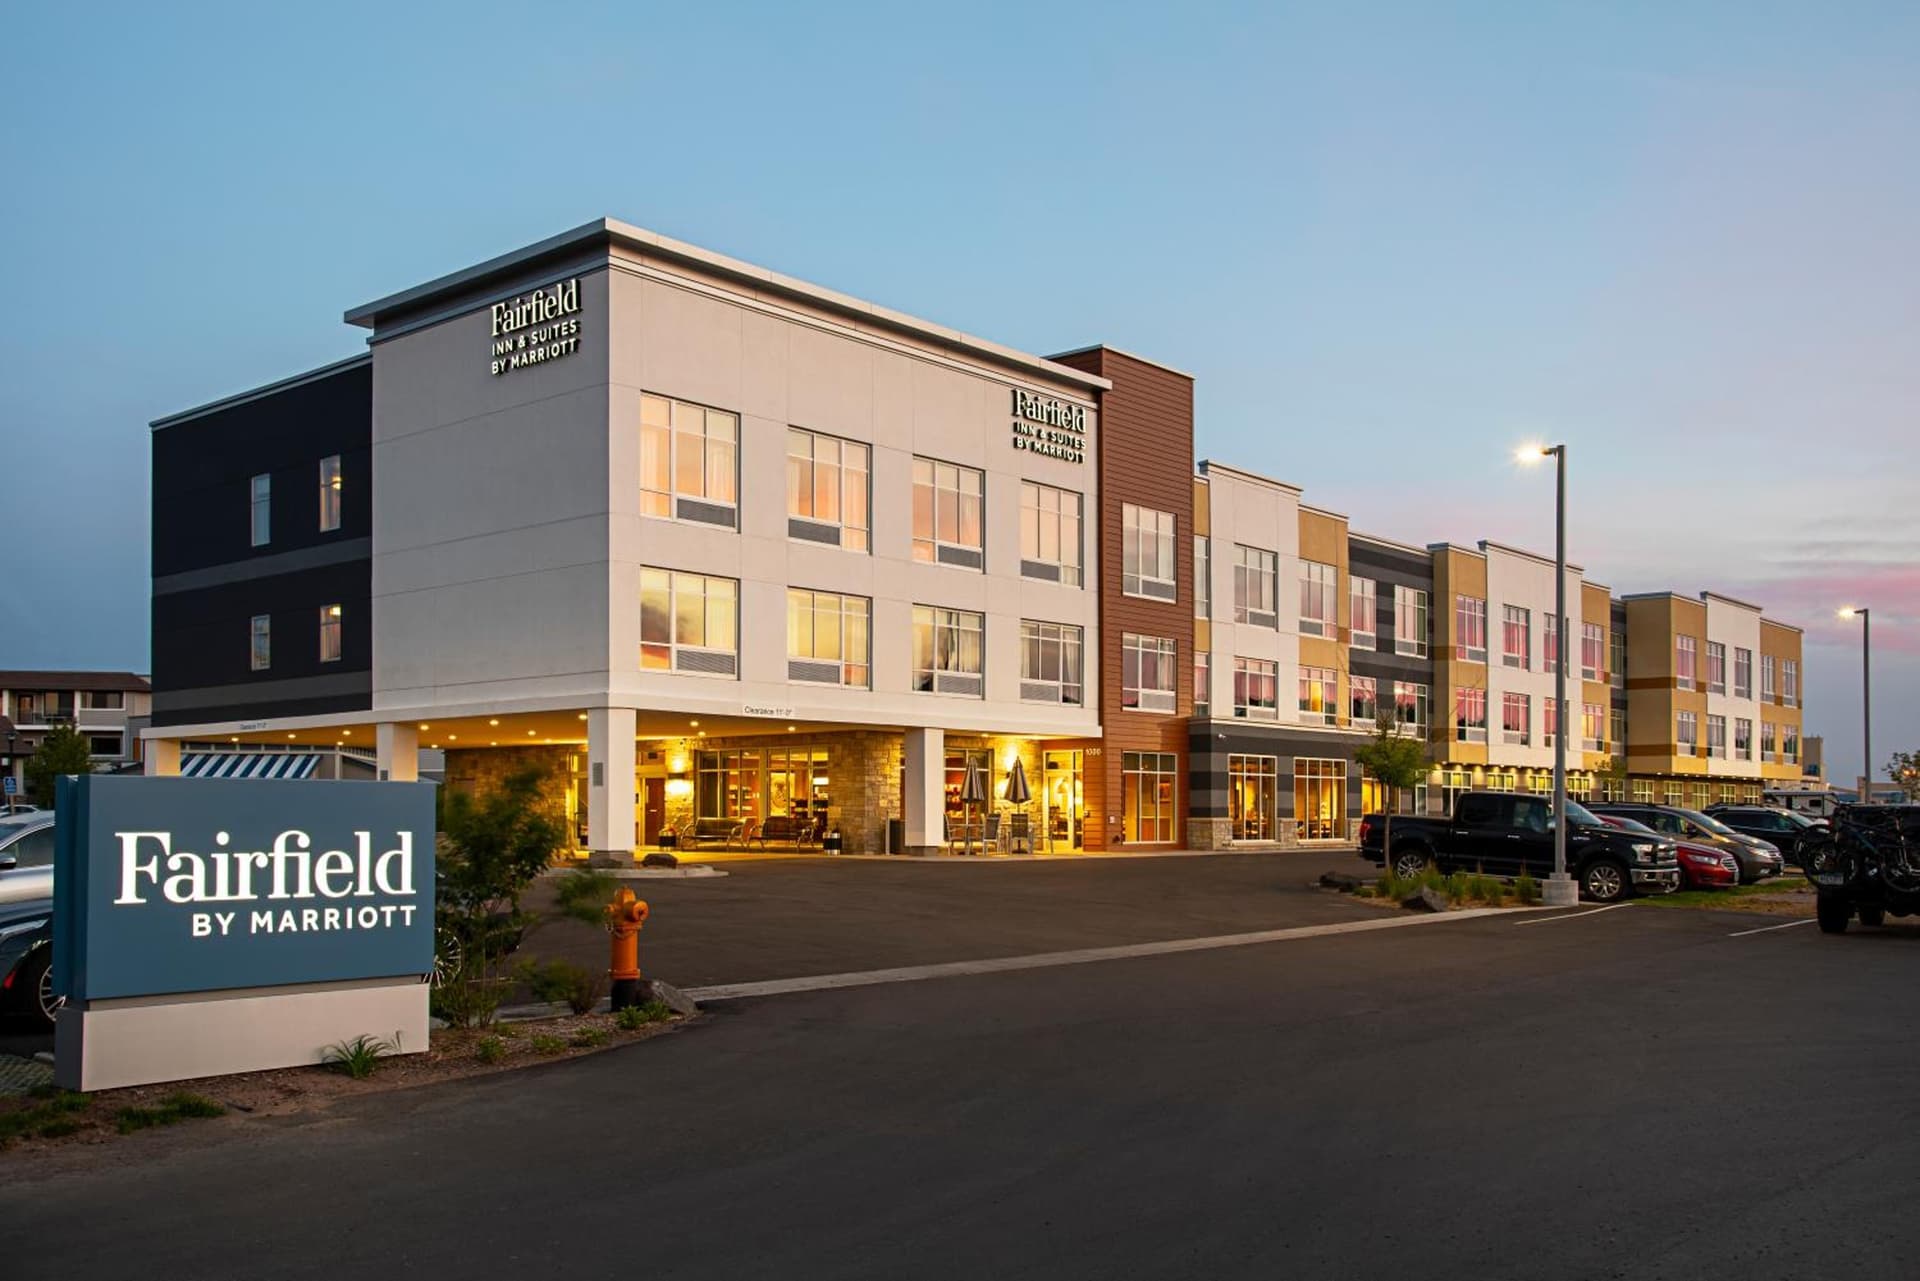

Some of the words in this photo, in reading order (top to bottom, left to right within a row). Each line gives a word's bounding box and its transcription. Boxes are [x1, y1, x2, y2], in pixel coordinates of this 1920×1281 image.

[491, 278, 578, 336] Fairfield
[492, 339, 513, 356] INN
[518, 335, 526, 348] &
[531, 319, 577, 345] SUITES
[492, 358, 506, 375] BY
[511, 338, 577, 369] MARRIOTT
[1015, 388, 1087, 433] Fairfield
[1016, 421, 1034, 434] INN
[1051, 431, 1087, 449] SUITES
[1017, 437, 1031, 448] BY
[1034, 441, 1086, 462] MARRIOTT
[113, 830, 417, 905] Fairfield
[192, 912, 236, 937] BY
[250, 905, 417, 934] MARRIOTT
